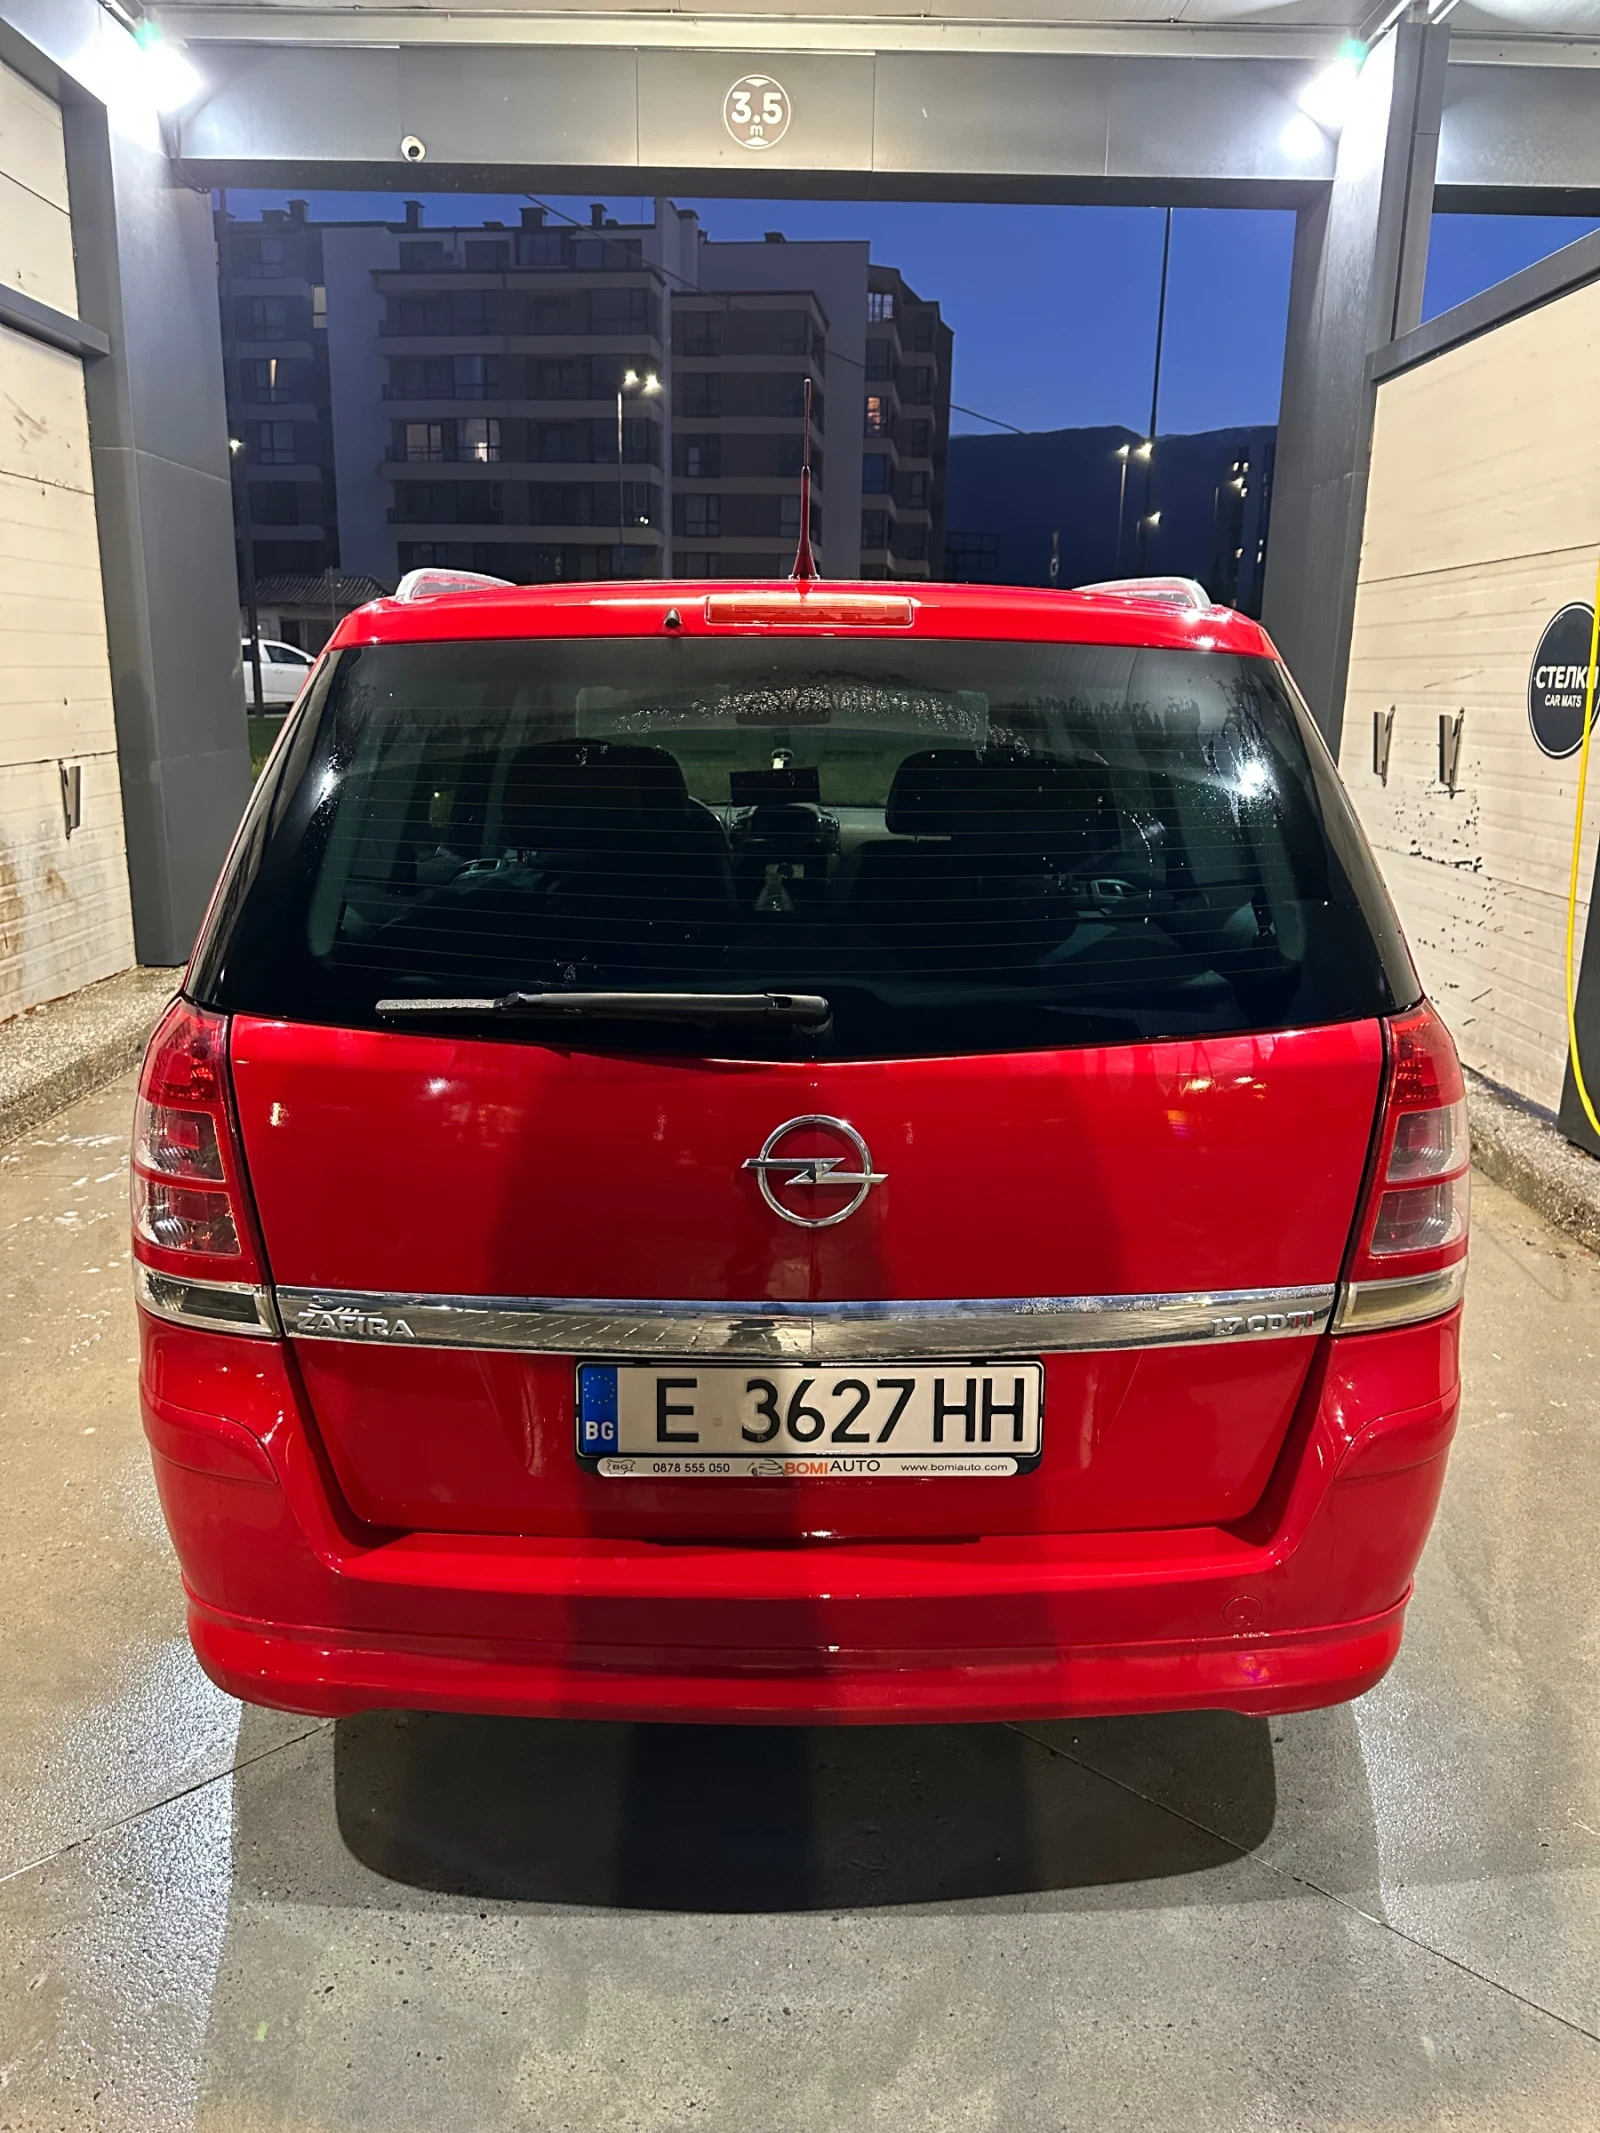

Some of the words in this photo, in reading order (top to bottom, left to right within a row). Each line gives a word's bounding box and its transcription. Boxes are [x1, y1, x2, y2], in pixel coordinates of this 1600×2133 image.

[731, 91, 782, 124] 3.5
[750, 125, 763, 136] m
[1544, 694, 1561, 707] CAR
[1561, 694, 1583, 708] MATS
[297, 1311, 416, 1338] ZAFIRA
[1246, 1310, 1314, 1333] CDTI
[656, 1378, 699, 1443] E
[741, 1377, 916, 1443] 3627
[933, 1375, 1025, 1443] HH
[585, 1421, 614, 1441] BG
[653, 1462, 681, 1473] 0878
[684, 1462, 706, 1473] 555
[709, 1462, 730, 1473] 050
[900, 1462, 1009, 1472] www.bomiauto.com
